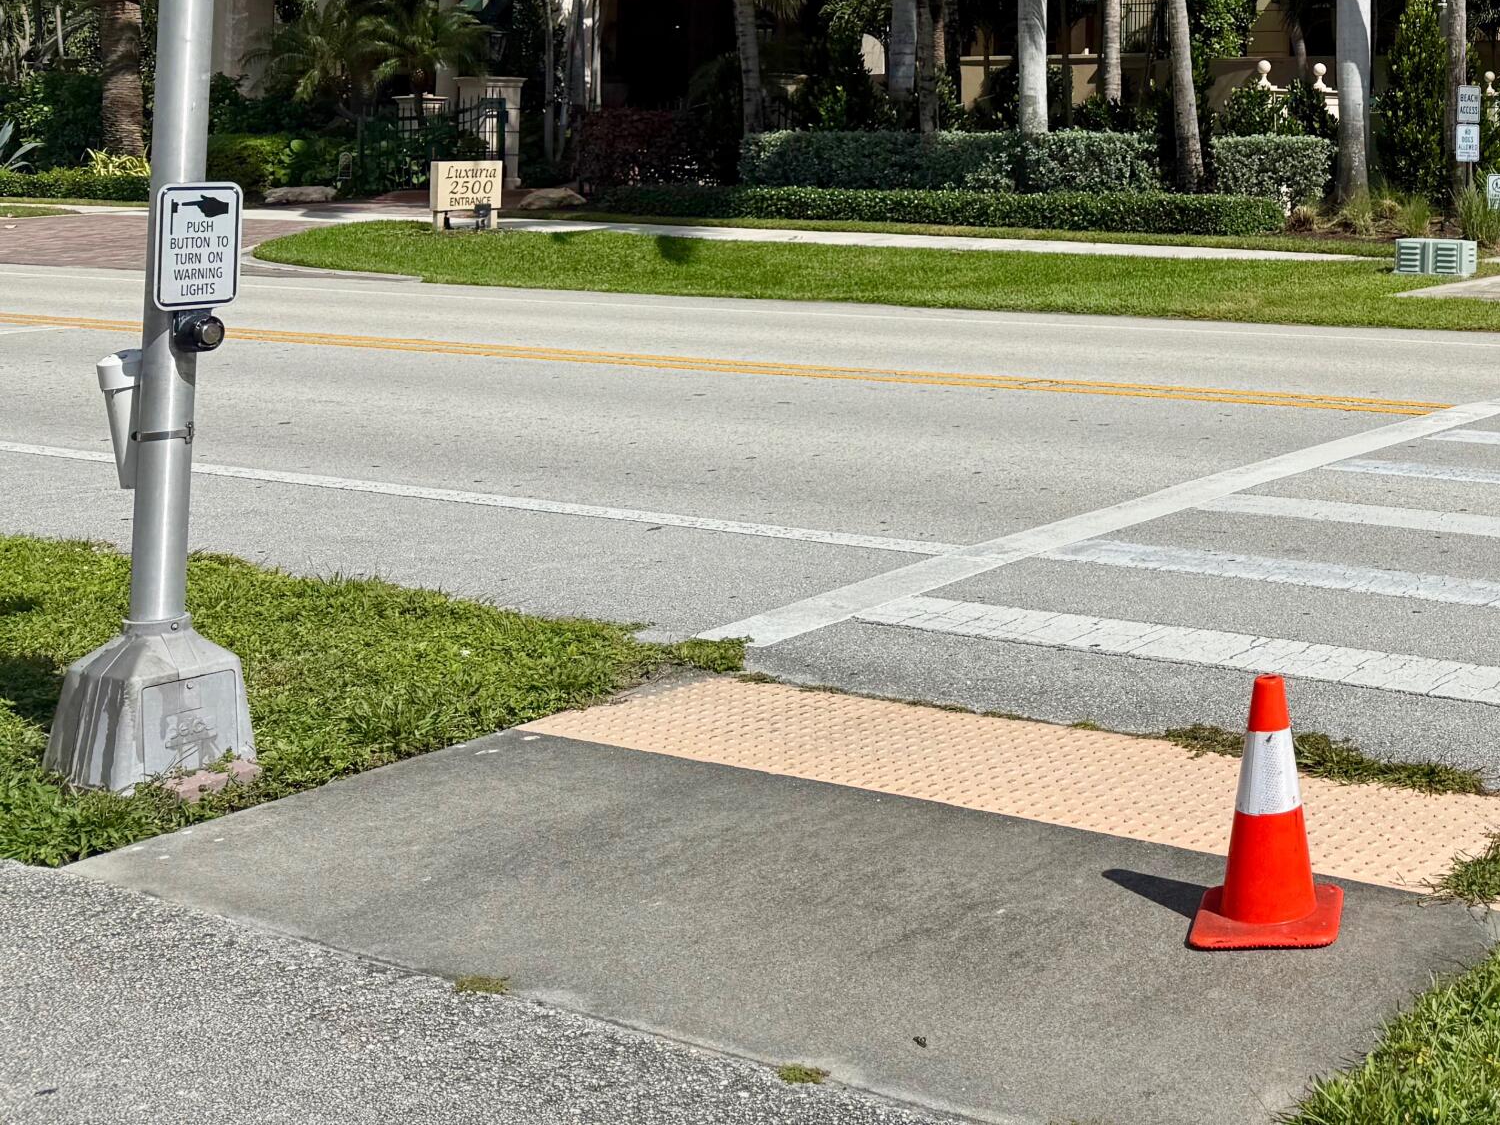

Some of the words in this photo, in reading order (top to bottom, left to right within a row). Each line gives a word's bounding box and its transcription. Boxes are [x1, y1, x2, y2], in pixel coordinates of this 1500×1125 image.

[1460, 93, 1479, 102] BEACH
[1460, 106, 1478, 115] ACCESS
[445, 165, 497, 179] Luxuria
[449, 180, 493, 195] 2500
[449, 196, 491, 206] ENTRANCE
[186, 221, 214, 233] PUSH
[170, 236, 210, 249] BUTTON
[216, 235, 229, 248] TO
[174, 252, 202, 265] TURN
[207, 251, 223, 264] ON
[173, 267, 223, 281] WARNING
[180, 283, 215, 296] LIGHTS
